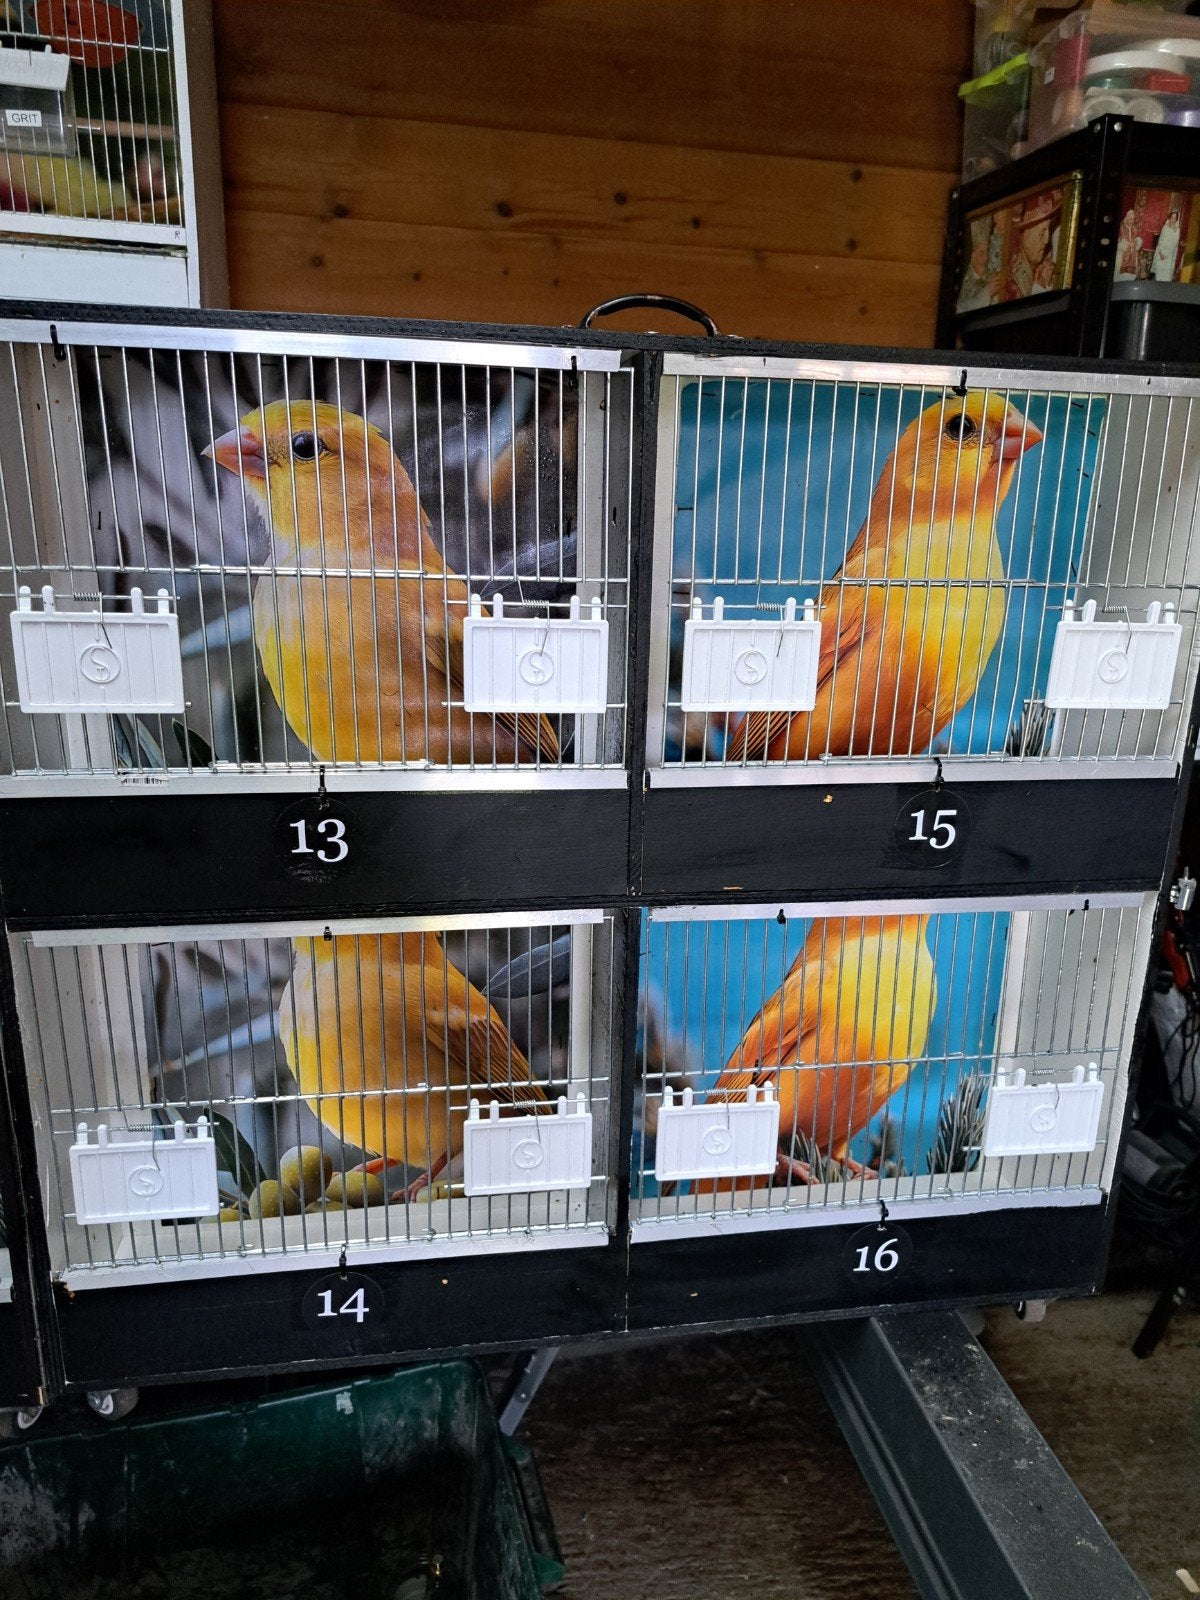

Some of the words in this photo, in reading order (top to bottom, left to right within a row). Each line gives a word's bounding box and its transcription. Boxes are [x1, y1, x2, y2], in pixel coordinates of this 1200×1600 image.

[11, 112, 38, 123] GRIT
[289, 818, 349, 863] 13
[908, 809, 958, 850] 15
[852, 1237, 899, 1272] 16
[317, 1287, 370, 1323] 14
